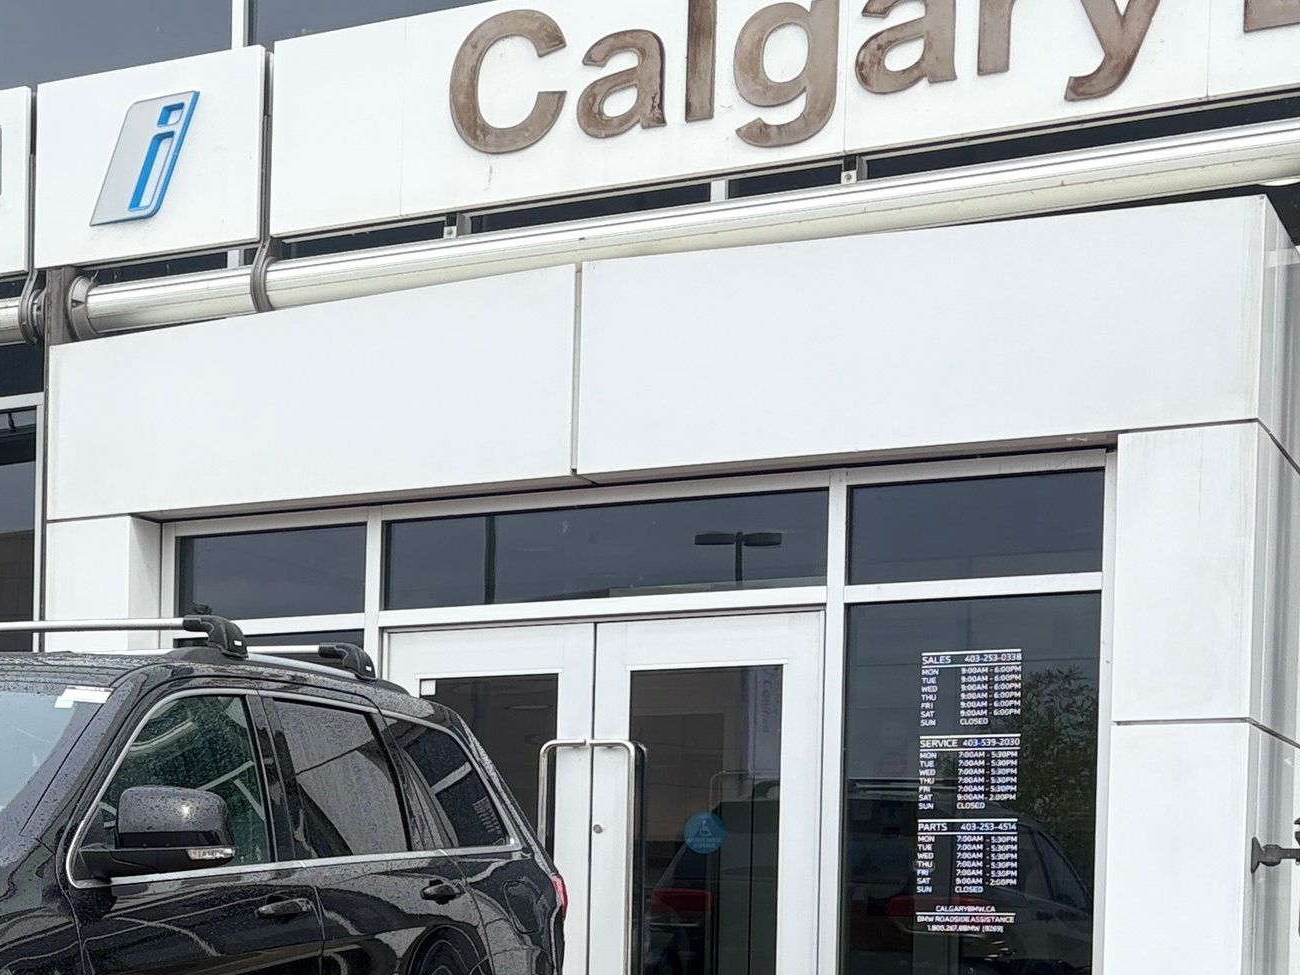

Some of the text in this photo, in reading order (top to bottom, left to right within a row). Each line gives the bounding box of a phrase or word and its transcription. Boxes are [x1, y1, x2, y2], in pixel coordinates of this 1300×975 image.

[448, 0, 1162, 155] Calgary
[922, 653, 1022, 665] SALES 403-253-0338
[922, 668, 939, 676] MON
[920, 719, 936, 727] SUN
[920, 738, 1020, 748] SERVICE 403-539-2030
[918, 823, 1017, 831] PARTS 403-253-4514
